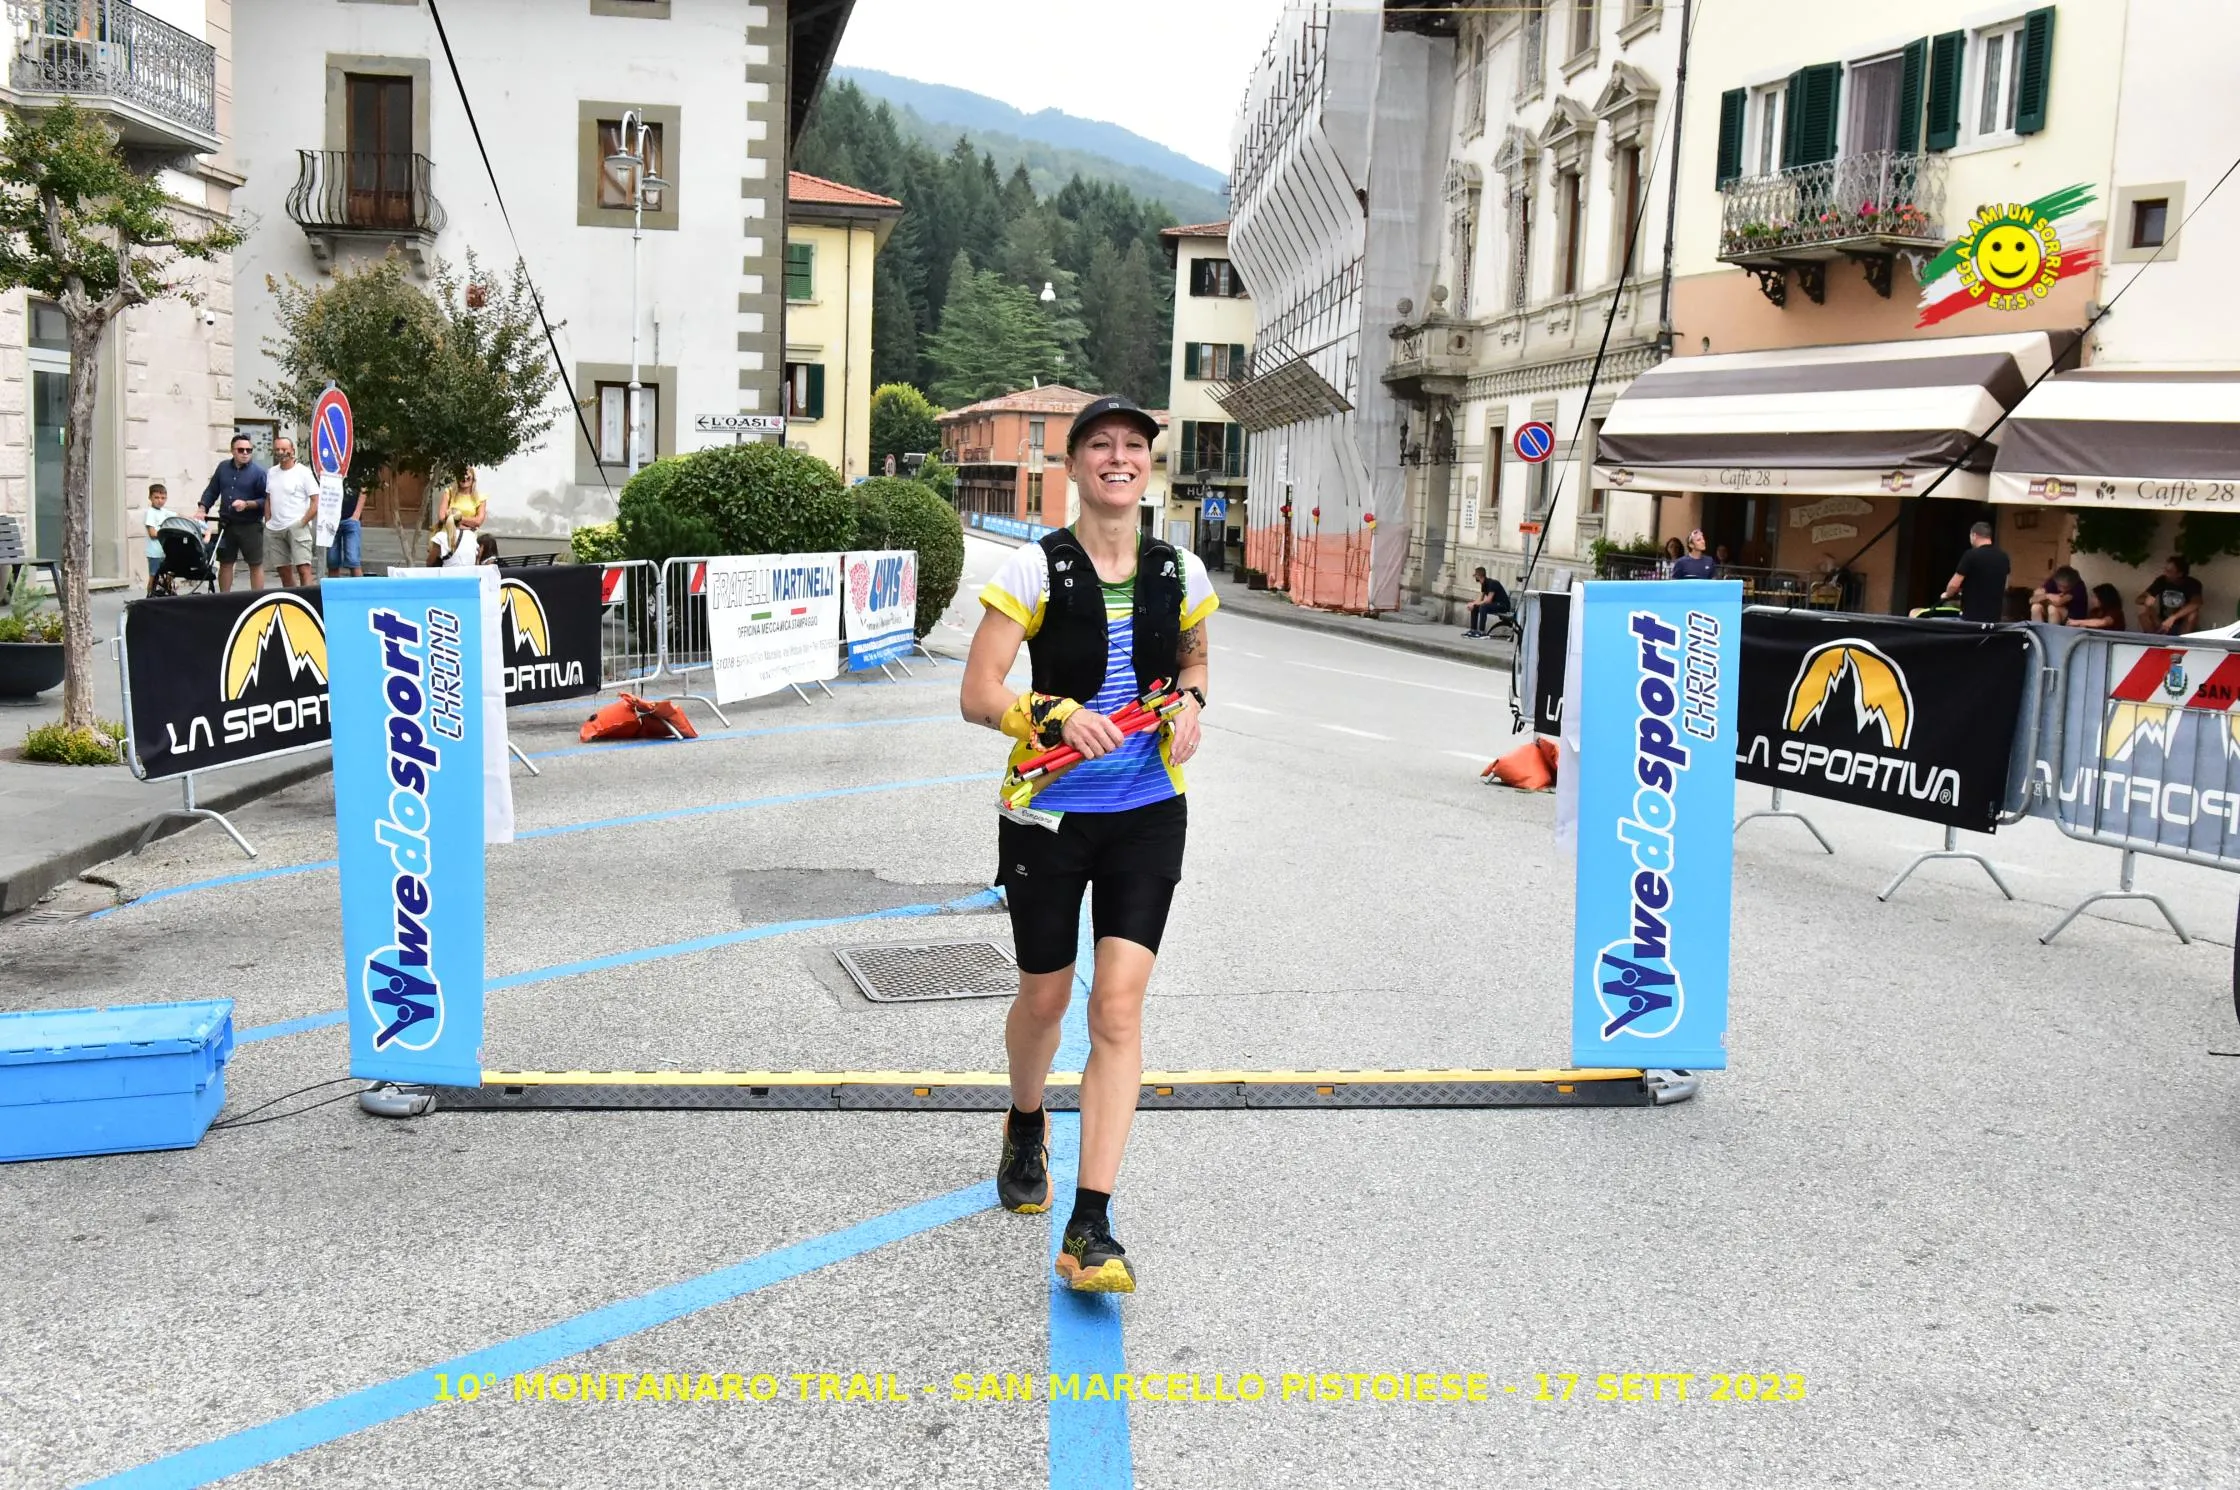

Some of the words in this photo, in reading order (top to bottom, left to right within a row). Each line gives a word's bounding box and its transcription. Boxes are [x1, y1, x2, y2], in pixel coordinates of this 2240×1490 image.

[711, 416, 768, 427] L'OASI
[1755, 471, 1771, 487] 28
[2137, 480, 2199, 507] Caffè
[2205, 482, 2236, 502] 28
[712, 568, 770, 610] FRATELLI
[772, 566, 834, 602] MARTINELLI
[869, 555, 903, 613] AVIS
[427, 606, 464, 742] CHRONO
[1684, 610, 1721, 742] CHRONO
[2197, 683, 2232, 700] SAN
[166, 715, 215, 755] LA
[1777, 739, 1961, 807] SPORTIVA
